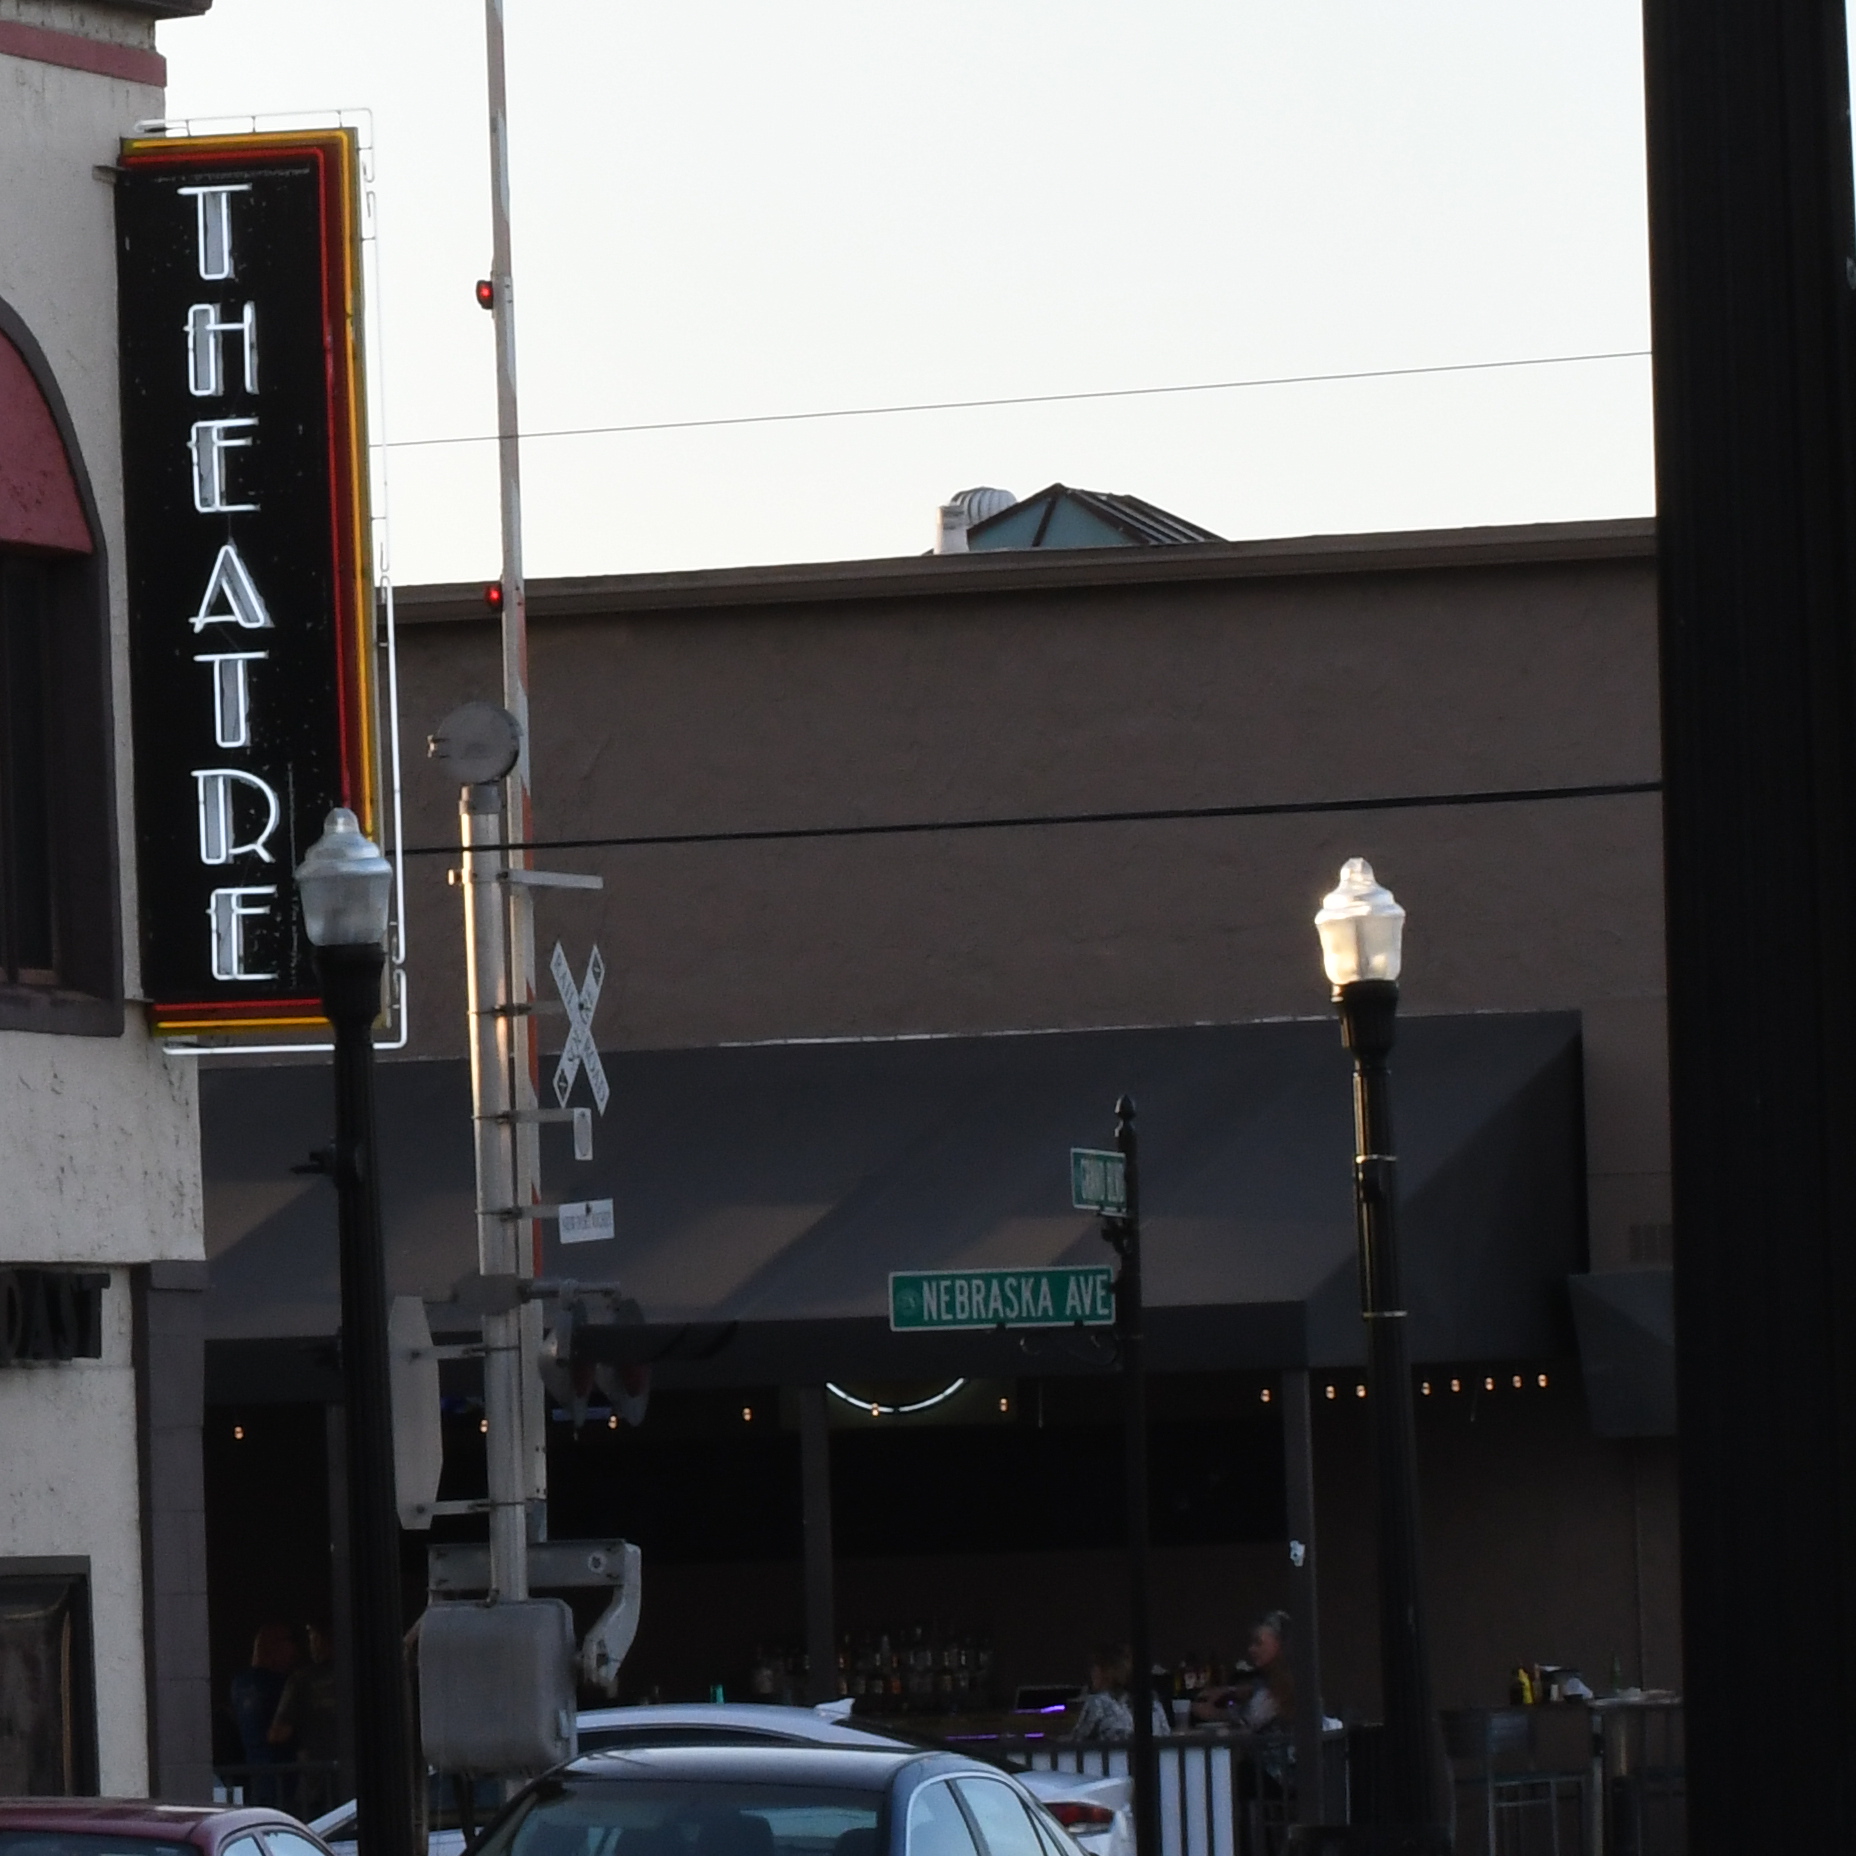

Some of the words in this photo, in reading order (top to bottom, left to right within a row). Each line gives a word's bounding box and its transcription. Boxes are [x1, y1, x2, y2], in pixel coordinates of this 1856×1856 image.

[176, 183, 280, 982] THEATRE
[922, 1277, 1054, 1320] NEBRASKA
[1065, 1274, 1109, 1316] AVE
